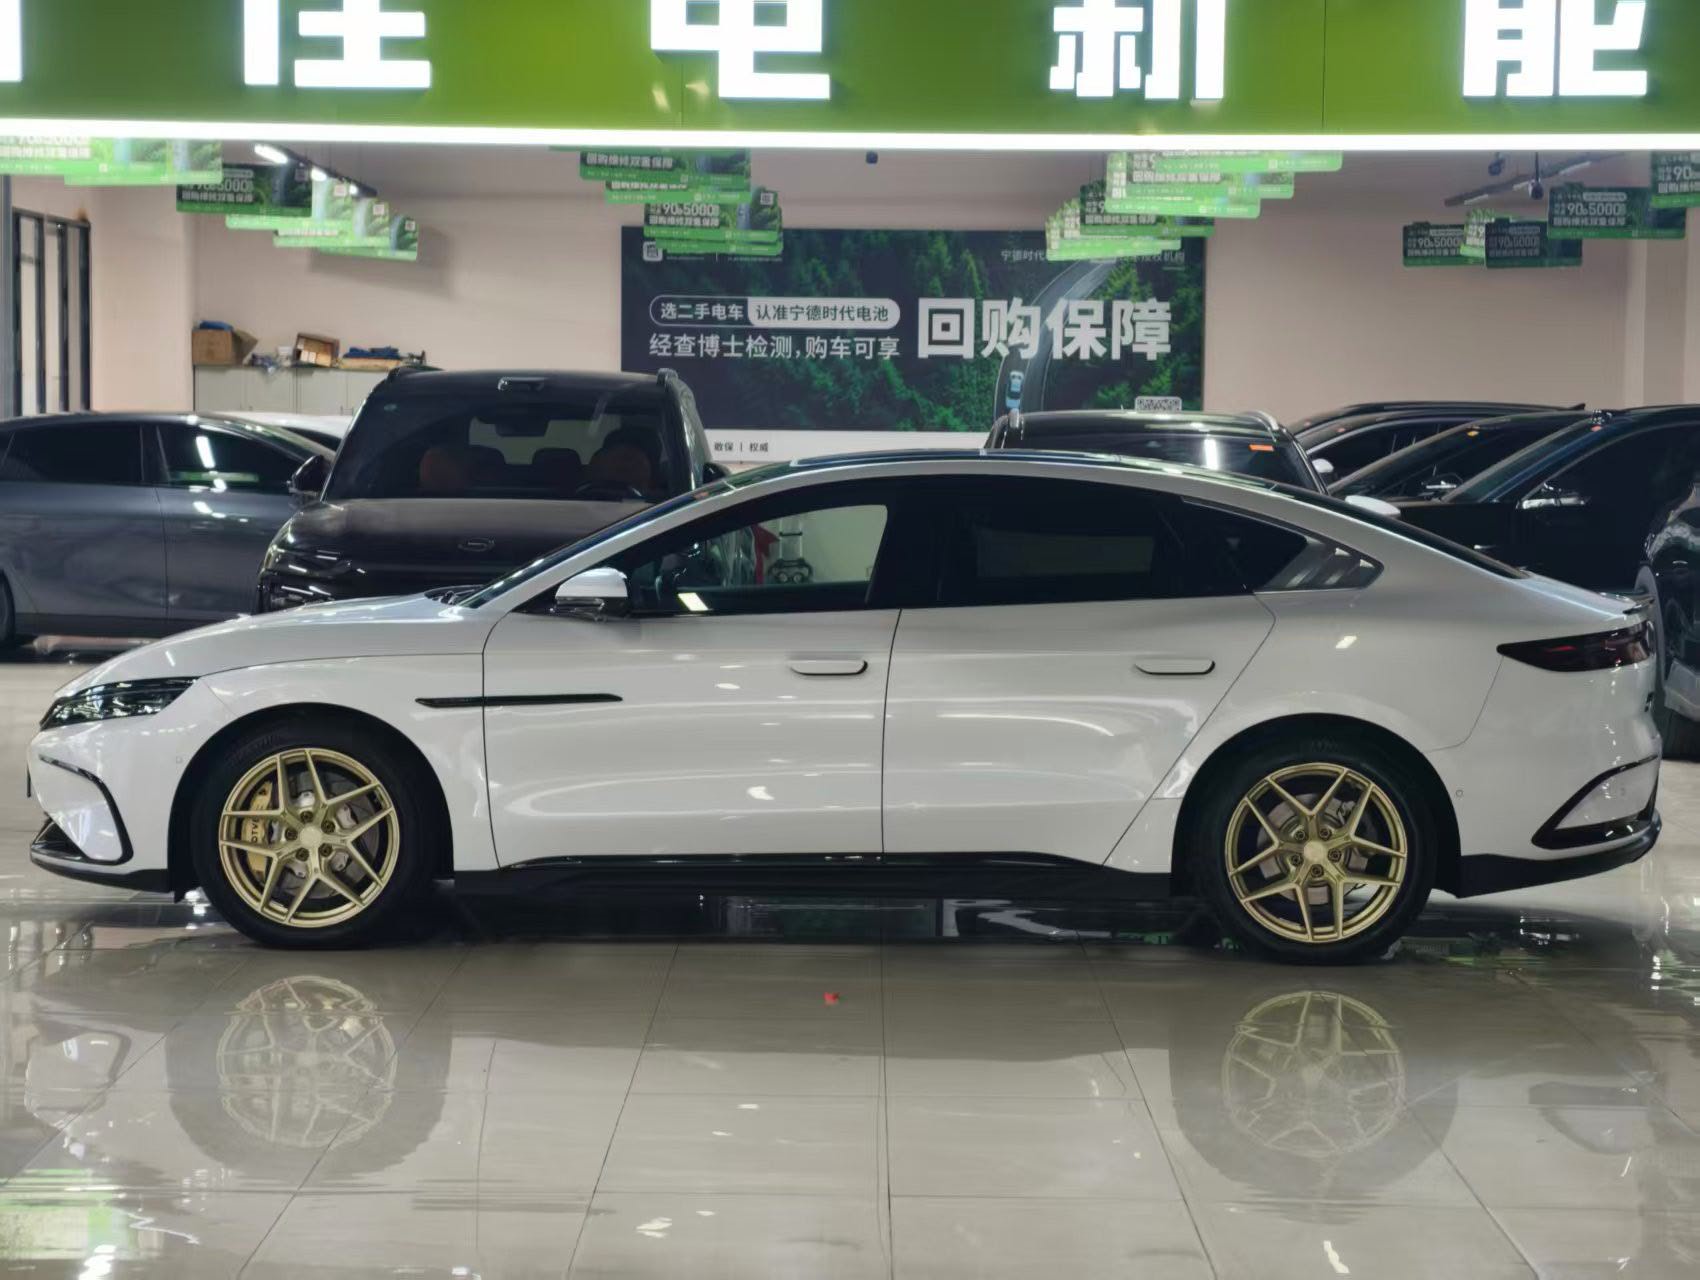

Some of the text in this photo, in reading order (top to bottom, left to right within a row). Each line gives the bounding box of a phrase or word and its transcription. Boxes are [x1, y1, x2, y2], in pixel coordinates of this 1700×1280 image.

[660, 302, 889, 322] 选二手电车 认准宁德时代电池
[918, 297, 1172, 361] 回购保障
[649, 333, 901, 360] 经查博士检测,购车可享
